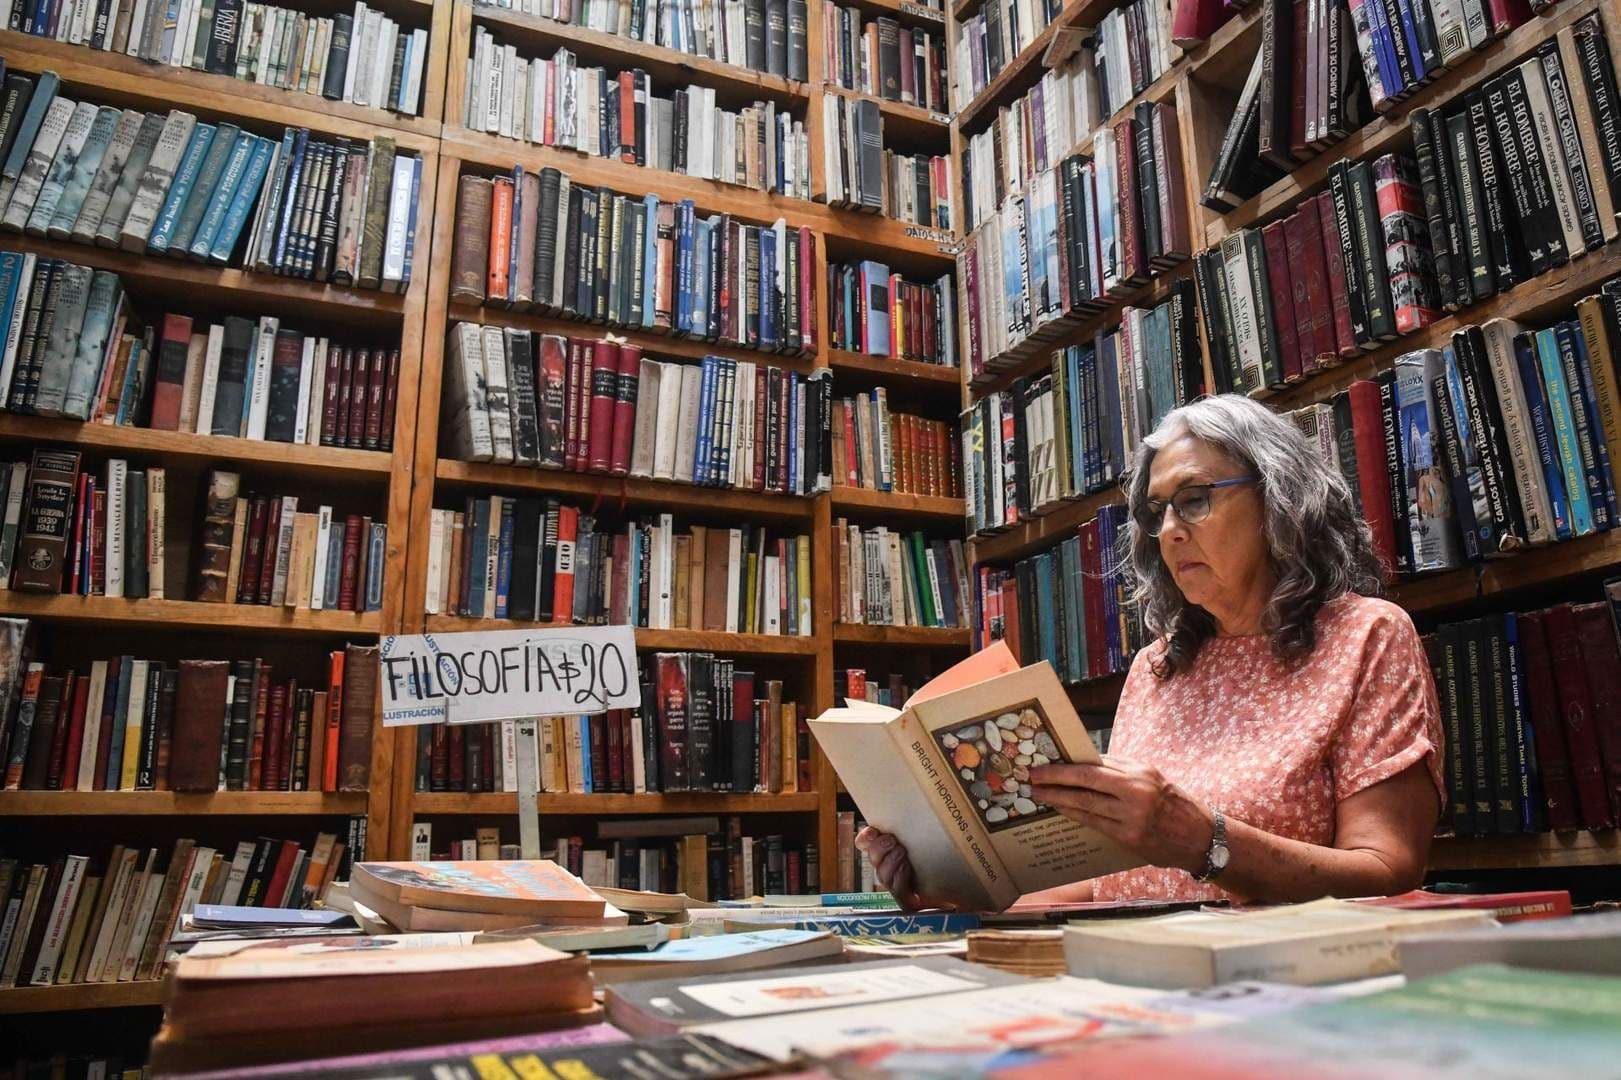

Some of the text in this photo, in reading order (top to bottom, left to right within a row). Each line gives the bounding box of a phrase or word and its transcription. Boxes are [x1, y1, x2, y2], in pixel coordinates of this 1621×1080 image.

[214, 8, 237, 43] IBERIA
[1386, 2, 1408, 67] EL MUNDO DE LA
[1329, 6, 1337, 108] EL MUNDO DE LA HISTORIA
[1593, 81, 1608, 110] DEL
[1488, 90, 1522, 175] EL HOMBRE
[1506, 79, 1540, 165] EL HOMBRE
[1600, 110, 1621, 173] HISTORIA
[1470, 101, 1497, 187] EL HOMBRE
[1550, 78, 1589, 209] CONOCER NUESTRO TIEMPO
[159, 219, 171, 233] Las
[178, 138, 205, 185] POSGUERRA
[198, 127, 209, 138] 2
[222, 146, 247, 192] POSGUERRA
[1331, 173, 1352, 252] EL HOMBRE
[1562, 205, 1573, 232] GRANDES
[1239, 295, 1251, 339] SIGLO XX
[1135, 368, 1144, 389] DIARY
[1464, 375, 1477, 406] ENGELS
[1502, 398, 1512, 412] del
[1558, 337, 1595, 469] LA SEGUNDA GUERRA MUNDIAL
[1379, 383, 1399, 472] EL HOMBRE
[1434, 378, 1462, 477] the world in figures
[1471, 407, 1487, 447] FEDERICO
[1508, 420, 1525, 456] Europa
[1530, 405, 1553, 465] WORLD HISTORY
[1550, 380, 1581, 501] the second Jewish catalog
[1483, 456, 1496, 485] MARX
[1516, 459, 1526, 471] de
[1490, 486, 1504, 522] CARLOS
[1519, 472, 1535, 511] Historia
[36, 524, 56, 533] 1945
[38, 516, 57, 525] 1939
[559, 643, 627, 704] $20
[1508, 645, 1516, 672] WORLD
[1511, 675, 1519, 706] STUDIES
[1515, 709, 1523, 742] MEDIEVAL
[1520, 774, 1529, 797] TODAY
[910, 740, 939, 779] BRIGHT
[965, 834, 973, 842] a
[970, 841, 999, 881] collection
